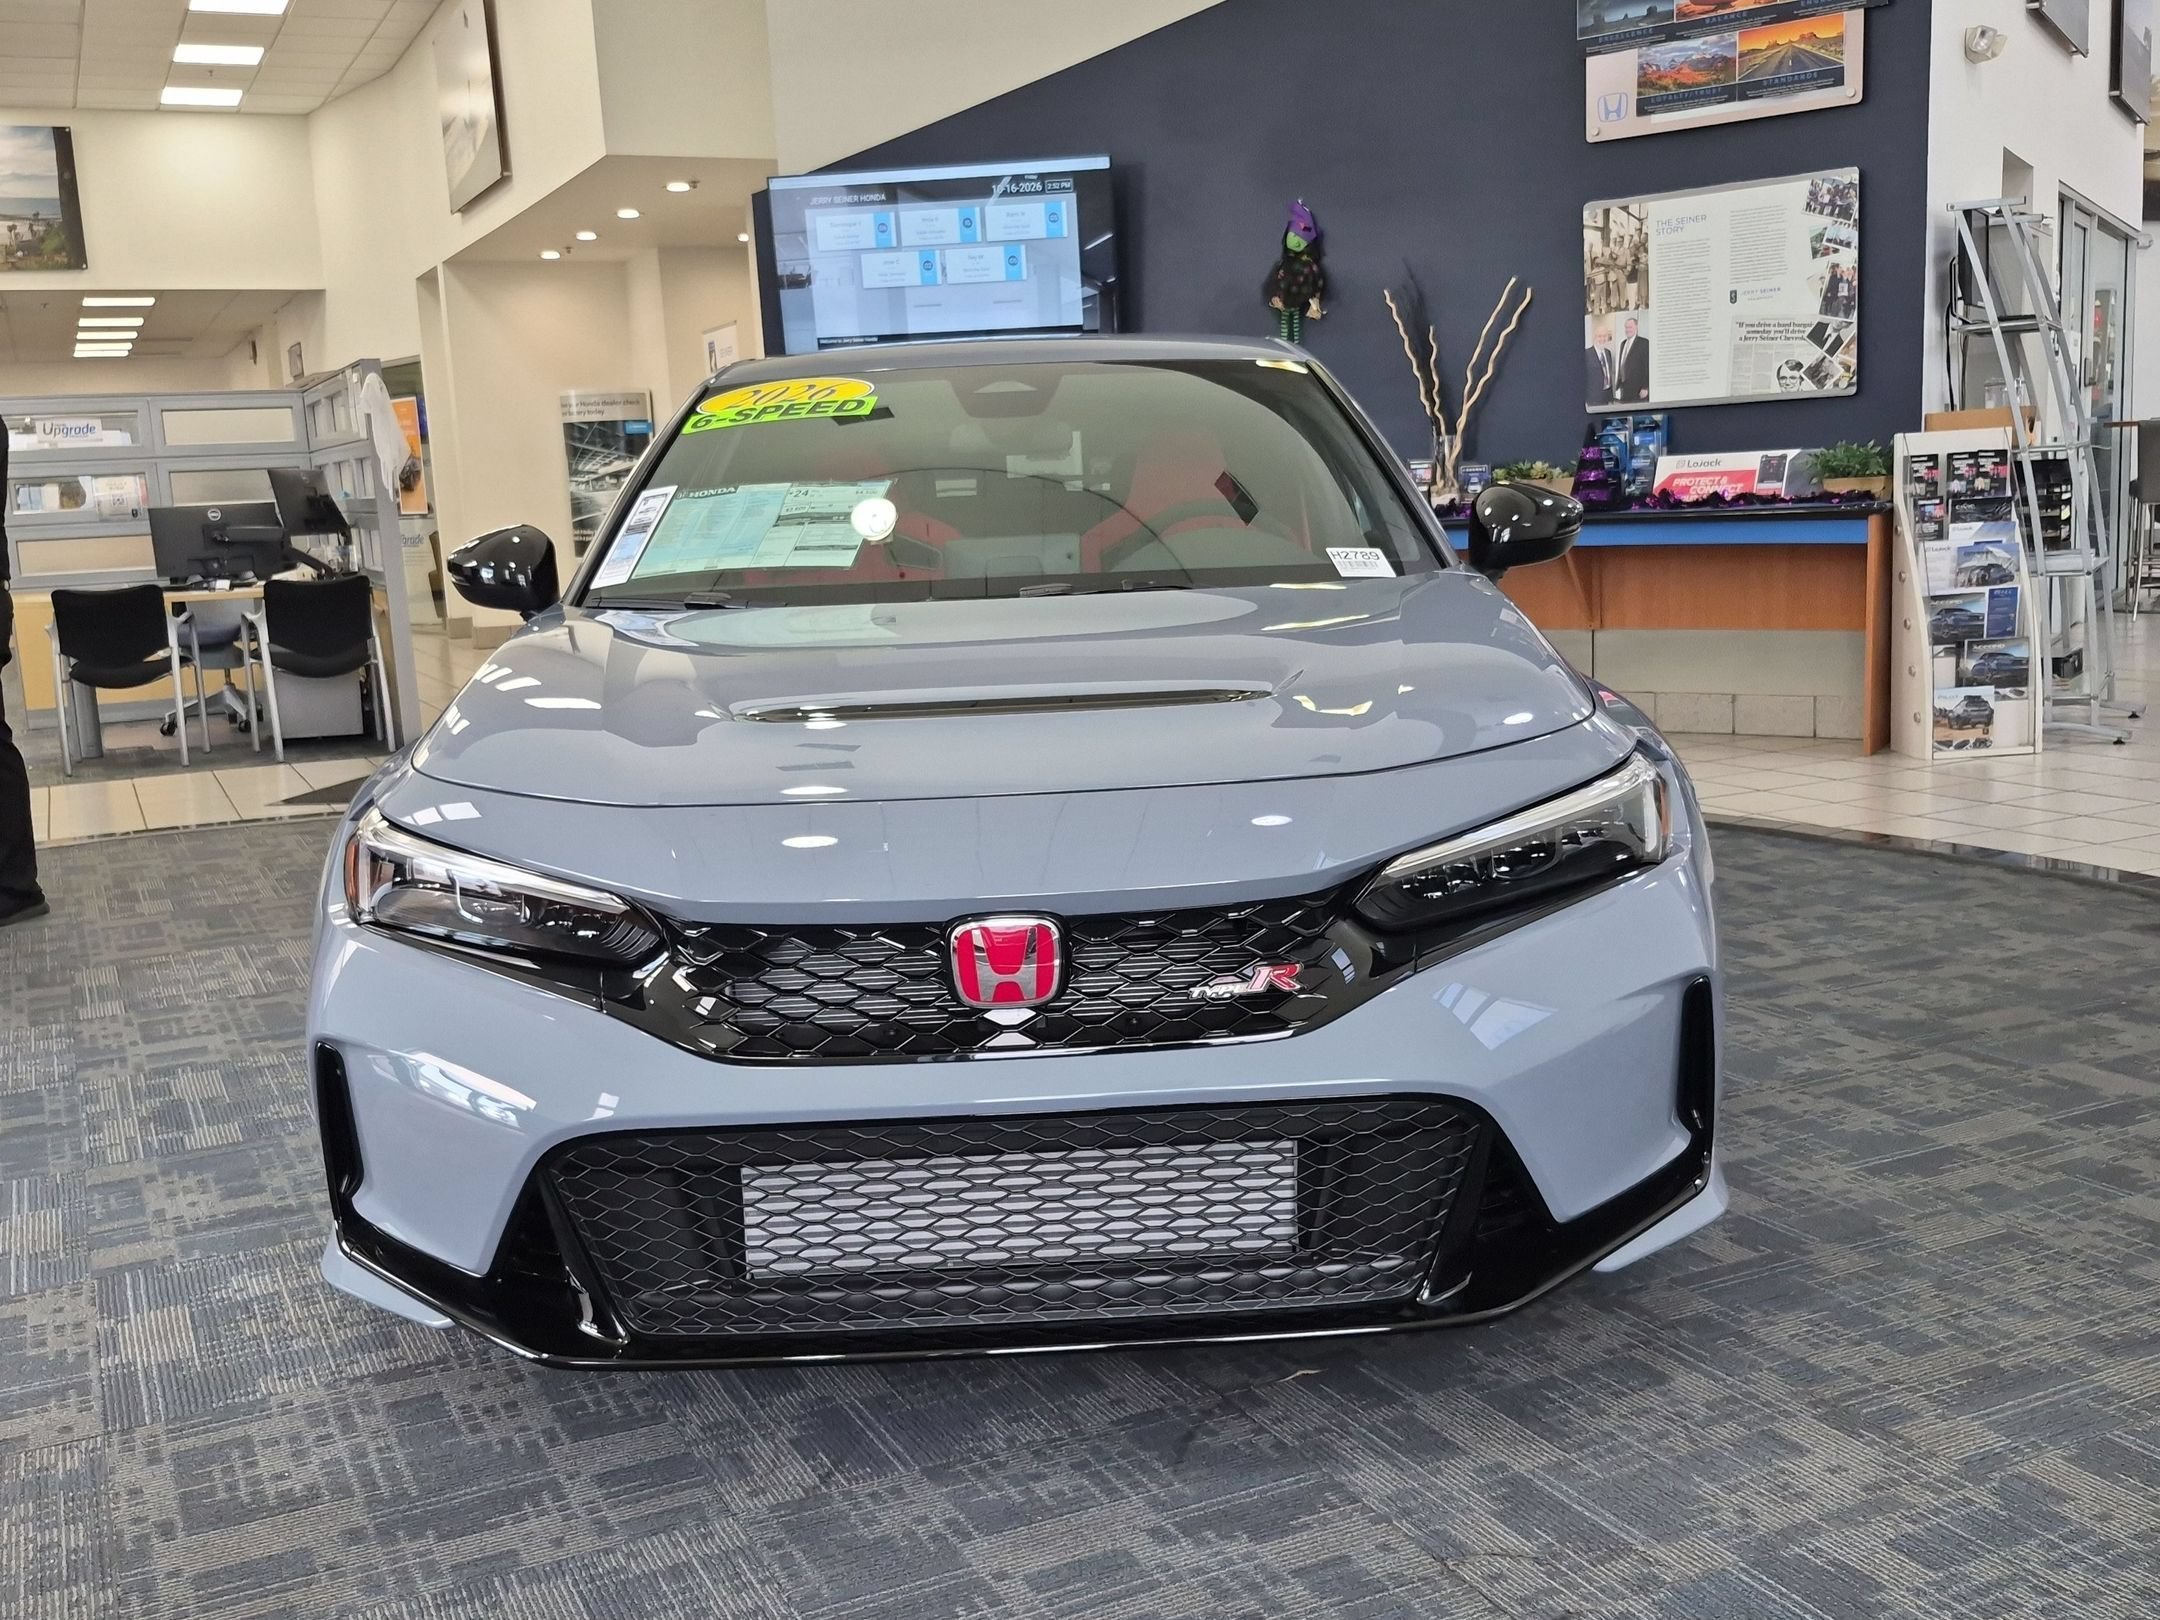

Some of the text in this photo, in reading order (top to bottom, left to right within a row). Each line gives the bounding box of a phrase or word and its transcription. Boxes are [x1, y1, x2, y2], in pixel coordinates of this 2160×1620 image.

[860, 192, 887, 203] HONDA
[1656, 214, 1707, 228] THE SEINER
[1655, 225, 1684, 236] STORY
[722, 381, 852, 410] 2026
[690, 398, 868, 430] 6-SPEED
[42, 423, 96, 438] Upgrade
[1672, 476, 1717, 487] PROTECT
[688, 487, 736, 498] HONDA
[1329, 550, 1380, 560] H2789
[1246, 962, 1302, 992] R
